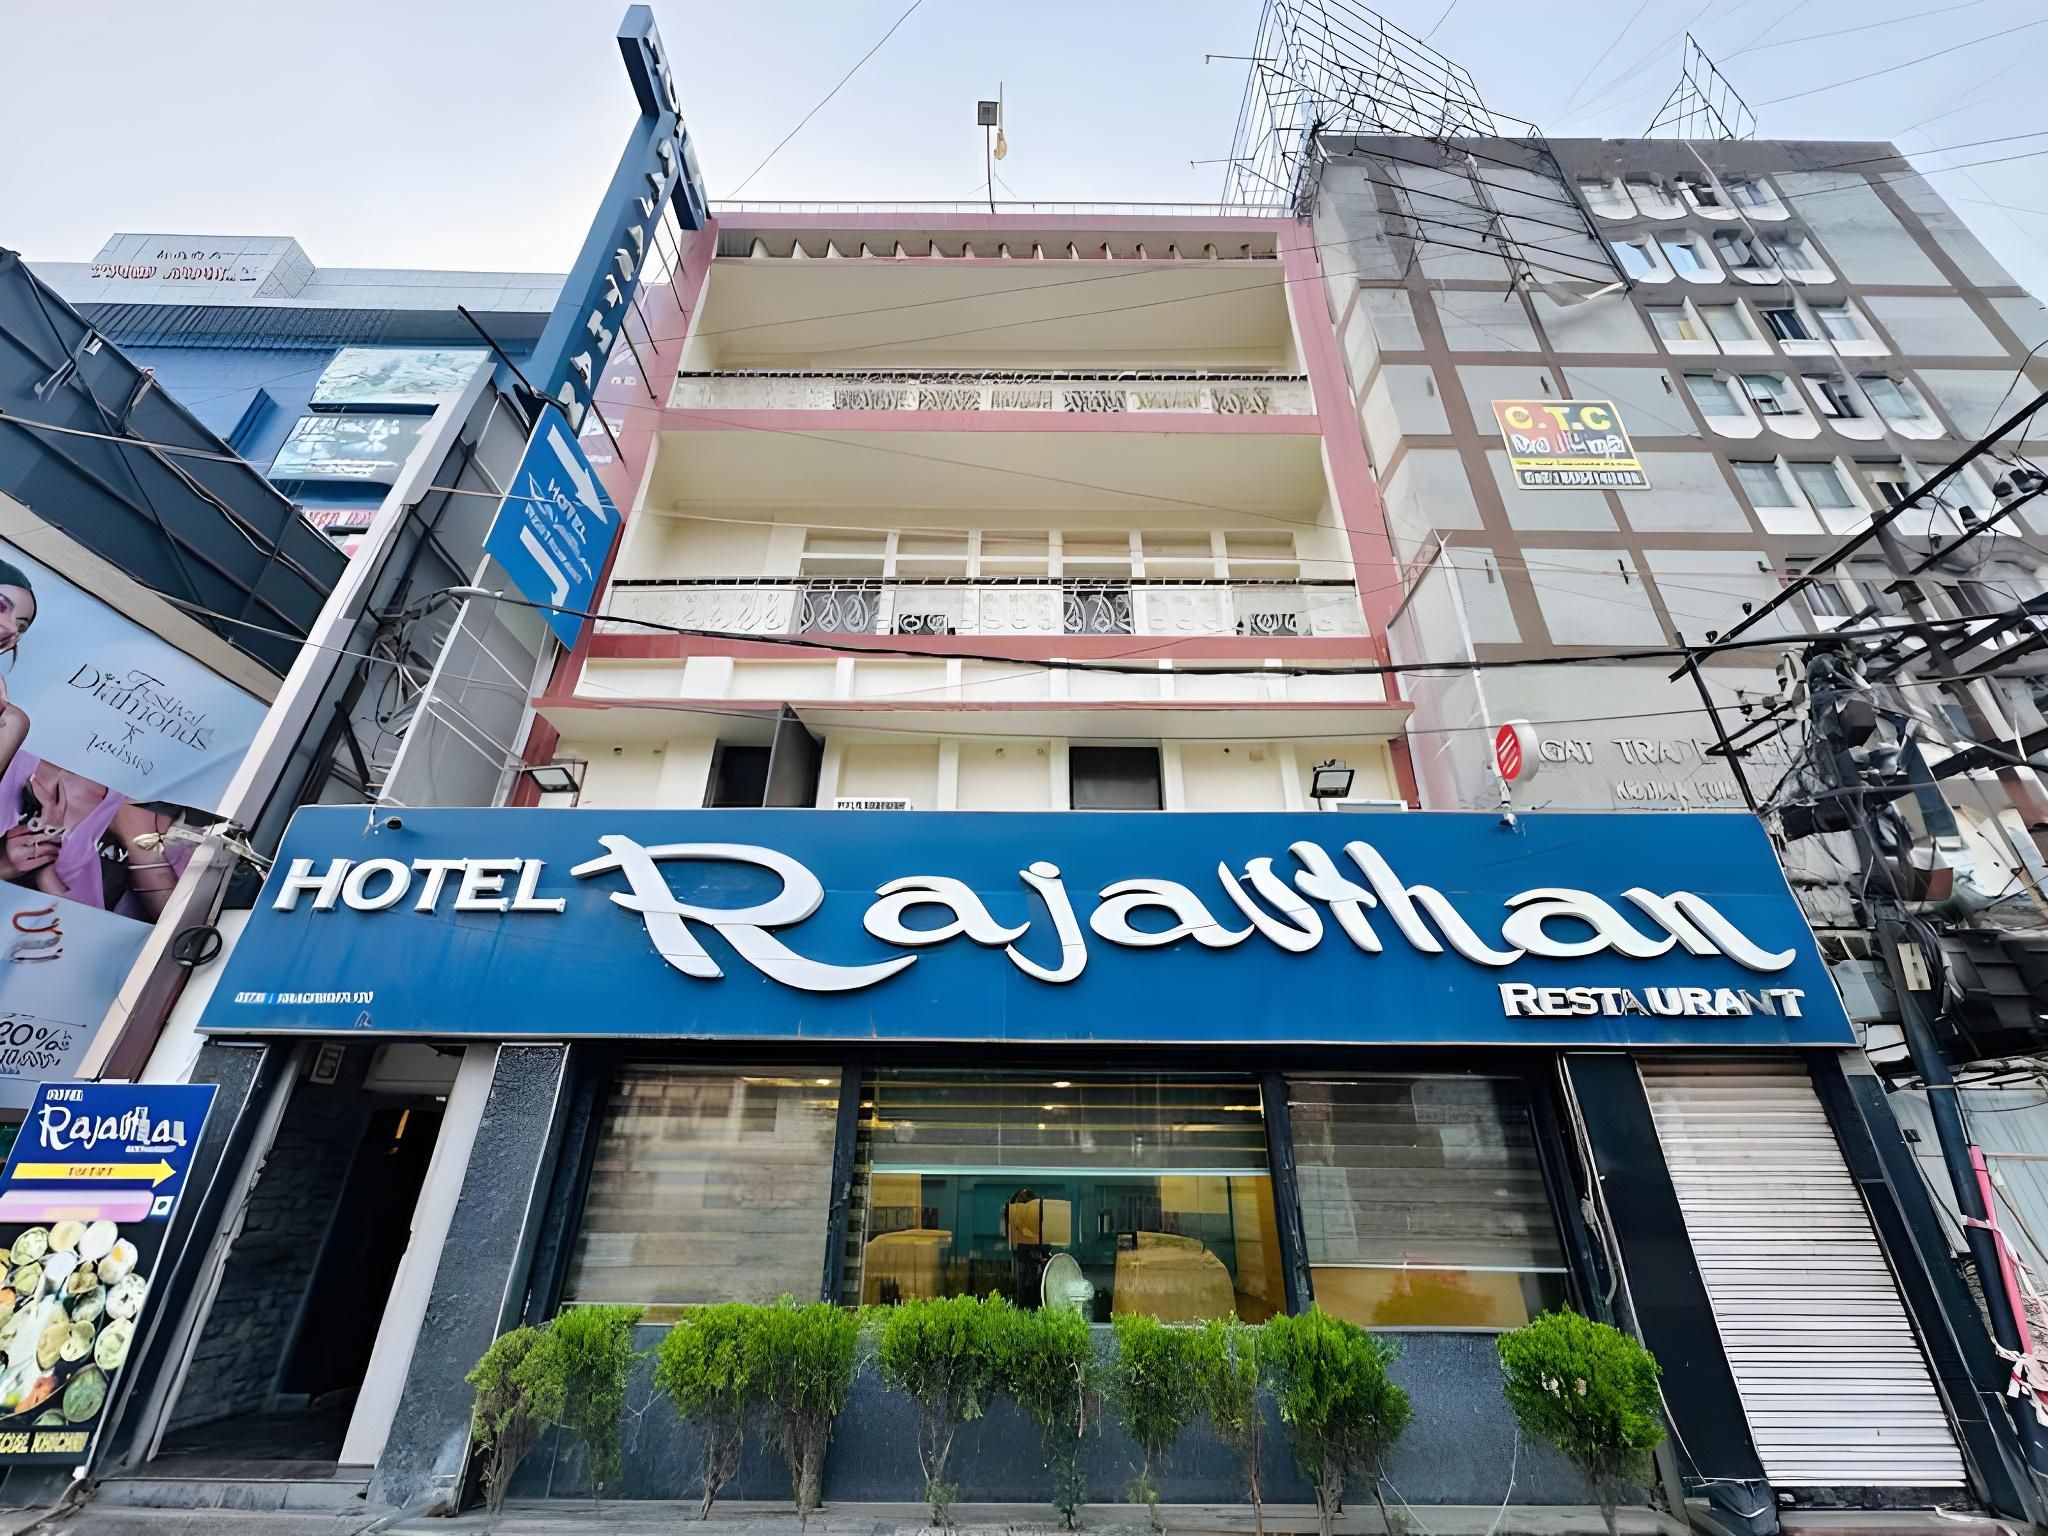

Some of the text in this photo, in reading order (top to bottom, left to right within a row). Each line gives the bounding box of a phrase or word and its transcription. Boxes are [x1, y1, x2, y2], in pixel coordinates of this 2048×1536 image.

[1538, 739, 1595, 765] GAT
[272, 857, 567, 913] HOTEL
[1498, 983, 1805, 1017] RESTAURANT
